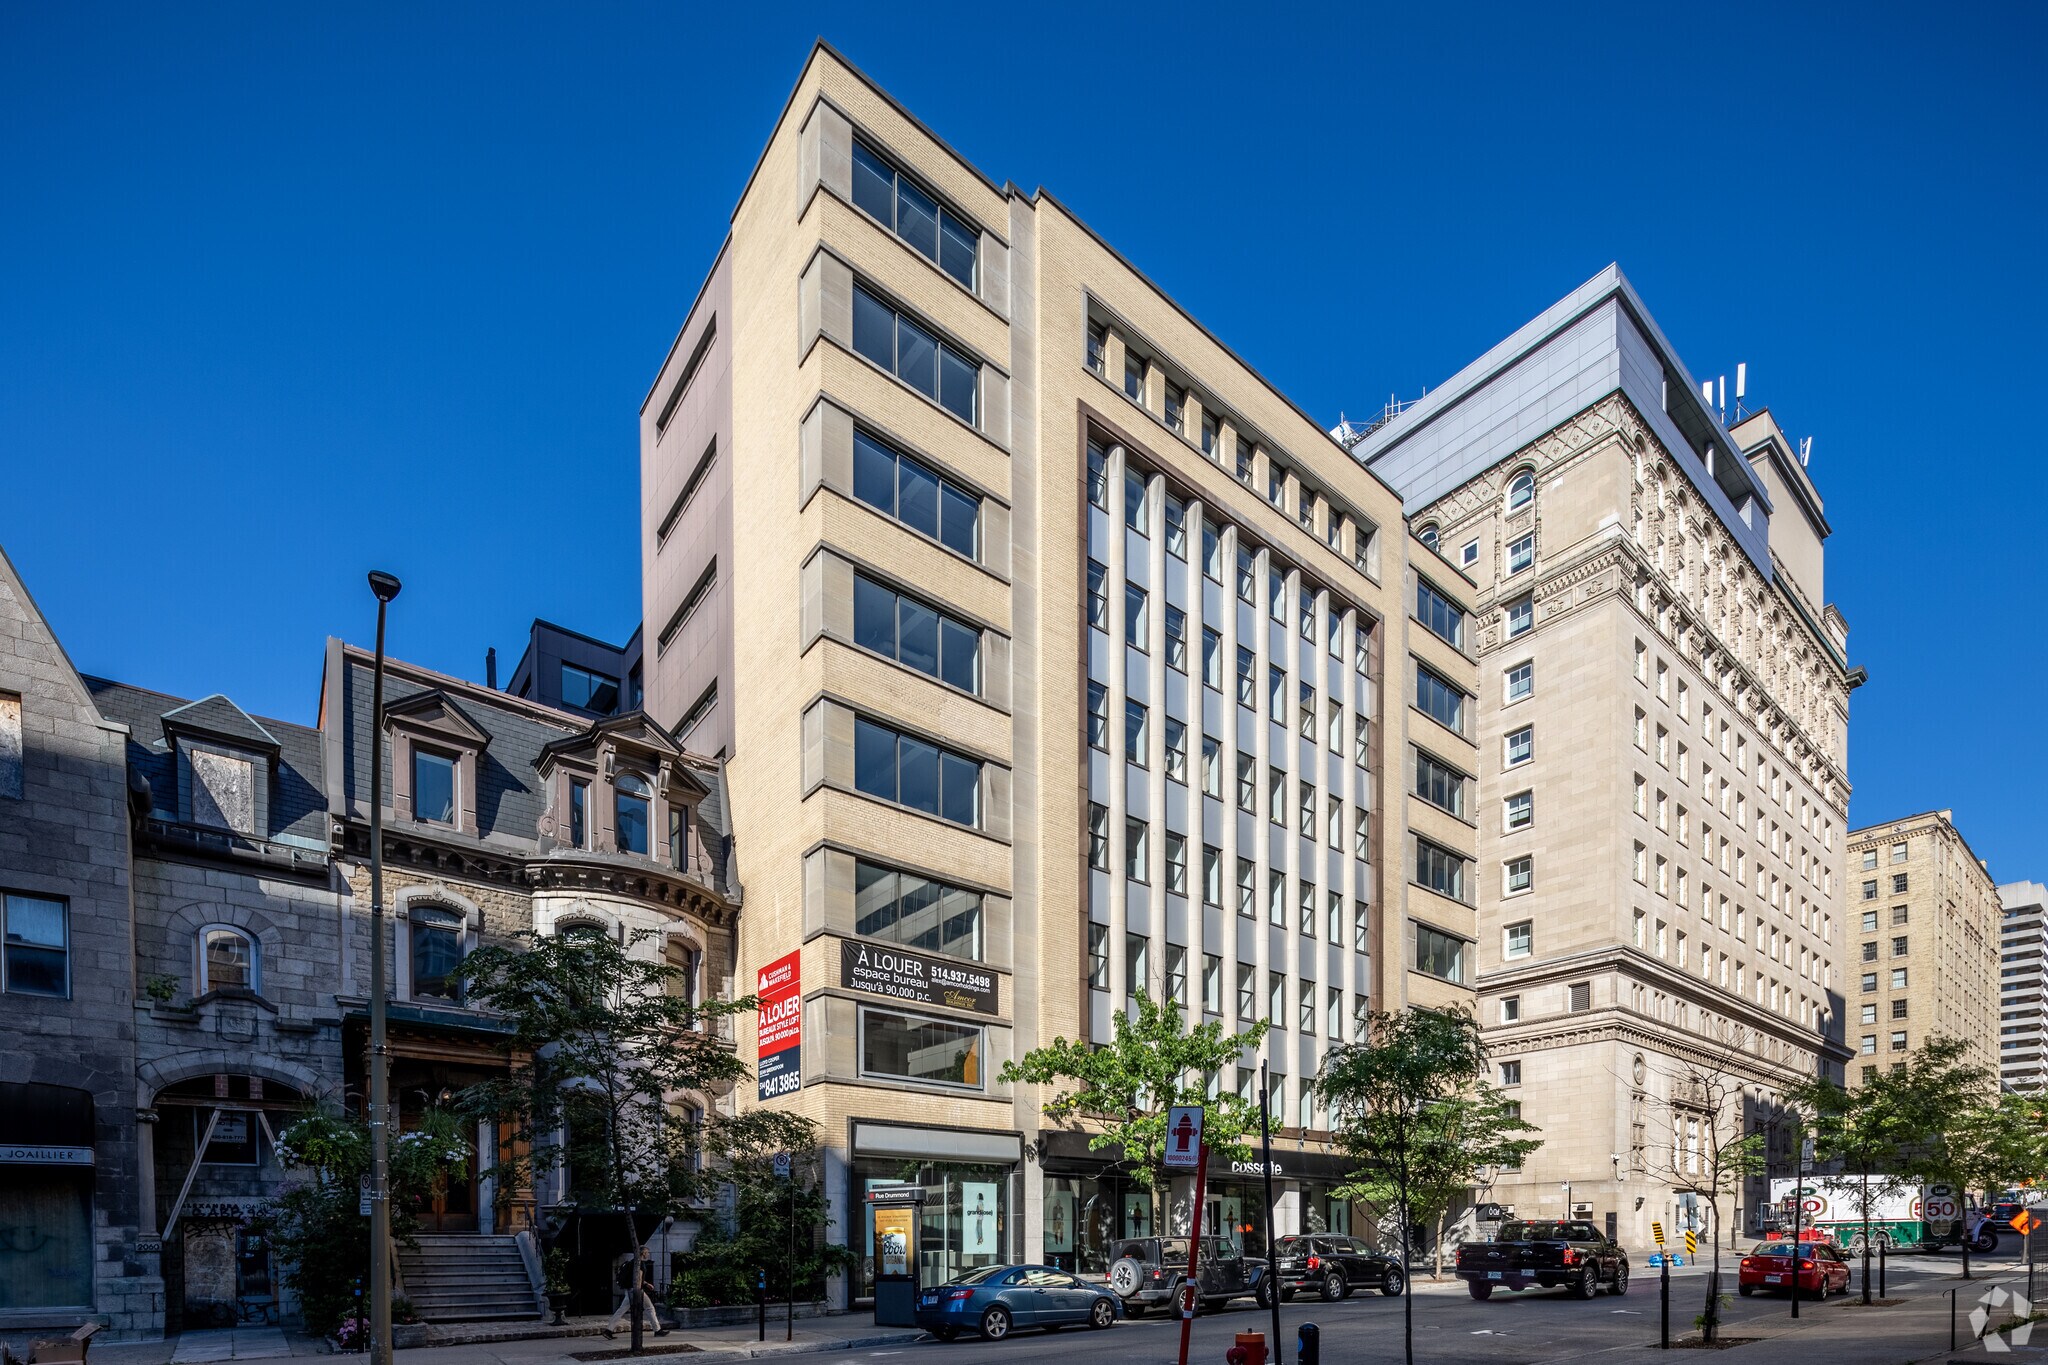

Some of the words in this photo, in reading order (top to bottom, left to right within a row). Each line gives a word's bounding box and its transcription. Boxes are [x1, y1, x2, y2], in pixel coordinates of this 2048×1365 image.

[858, 945, 869, 967] À
[874, 953, 924, 978] LOUER
[768, 965, 787, 980] CUSHMAN
[768, 971, 792, 986] WAKEFIELD
[853, 967, 890, 982] espace
[893, 974, 929, 989] bureau
[931, 966, 990, 988] 514.937.5498
[850, 977, 884, 993] Jusqu'à
[885, 984, 915, 999] 90,000
[916, 990, 932, 1002] p.c.
[767, 995, 800, 1024] LOUER
[777, 1018, 789, 1031] STYLE
[789, 1014, 799, 1027] LOFT
[9, 1150, 73, 1159] JOAILLIER
[884, 1191, 910, 1199] Drummond
[1927, 1202, 1955, 1217] 50
[137, 1243, 160, 1251] 2060
